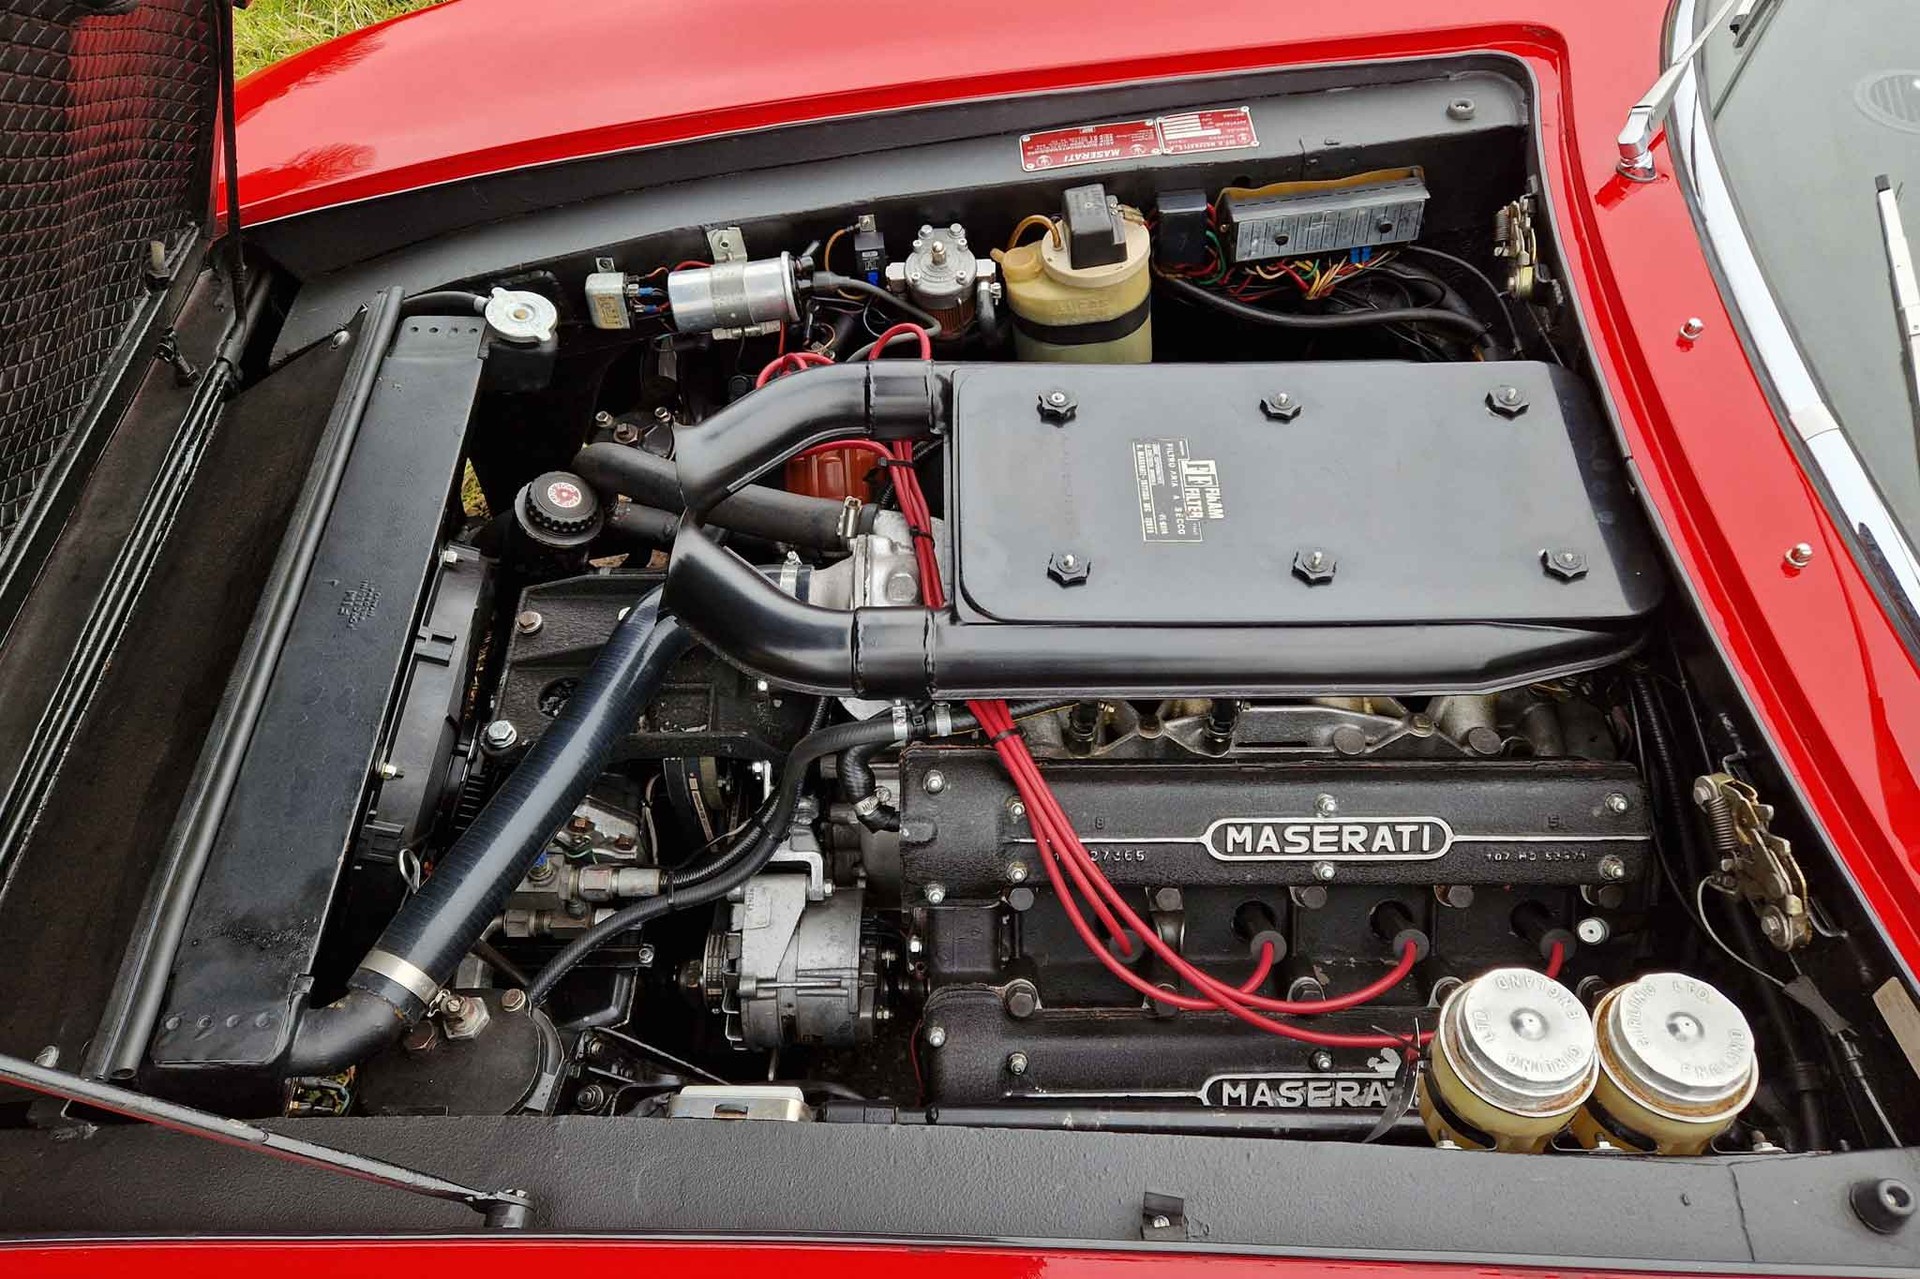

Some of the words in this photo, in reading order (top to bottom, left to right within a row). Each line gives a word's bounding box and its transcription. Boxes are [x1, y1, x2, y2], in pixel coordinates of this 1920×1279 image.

[1064, 148, 1120, 162] MASERATI
[1185, 487, 1204, 519] FILTER
[1174, 507, 1185, 535] SECCO
[1226, 825, 1431, 853] MASERATI
[1627, 982, 1656, 1048] GIRLING
[1506, 1045, 1583, 1073] GIRLING
[1222, 1081, 1399, 1107] MASERA
